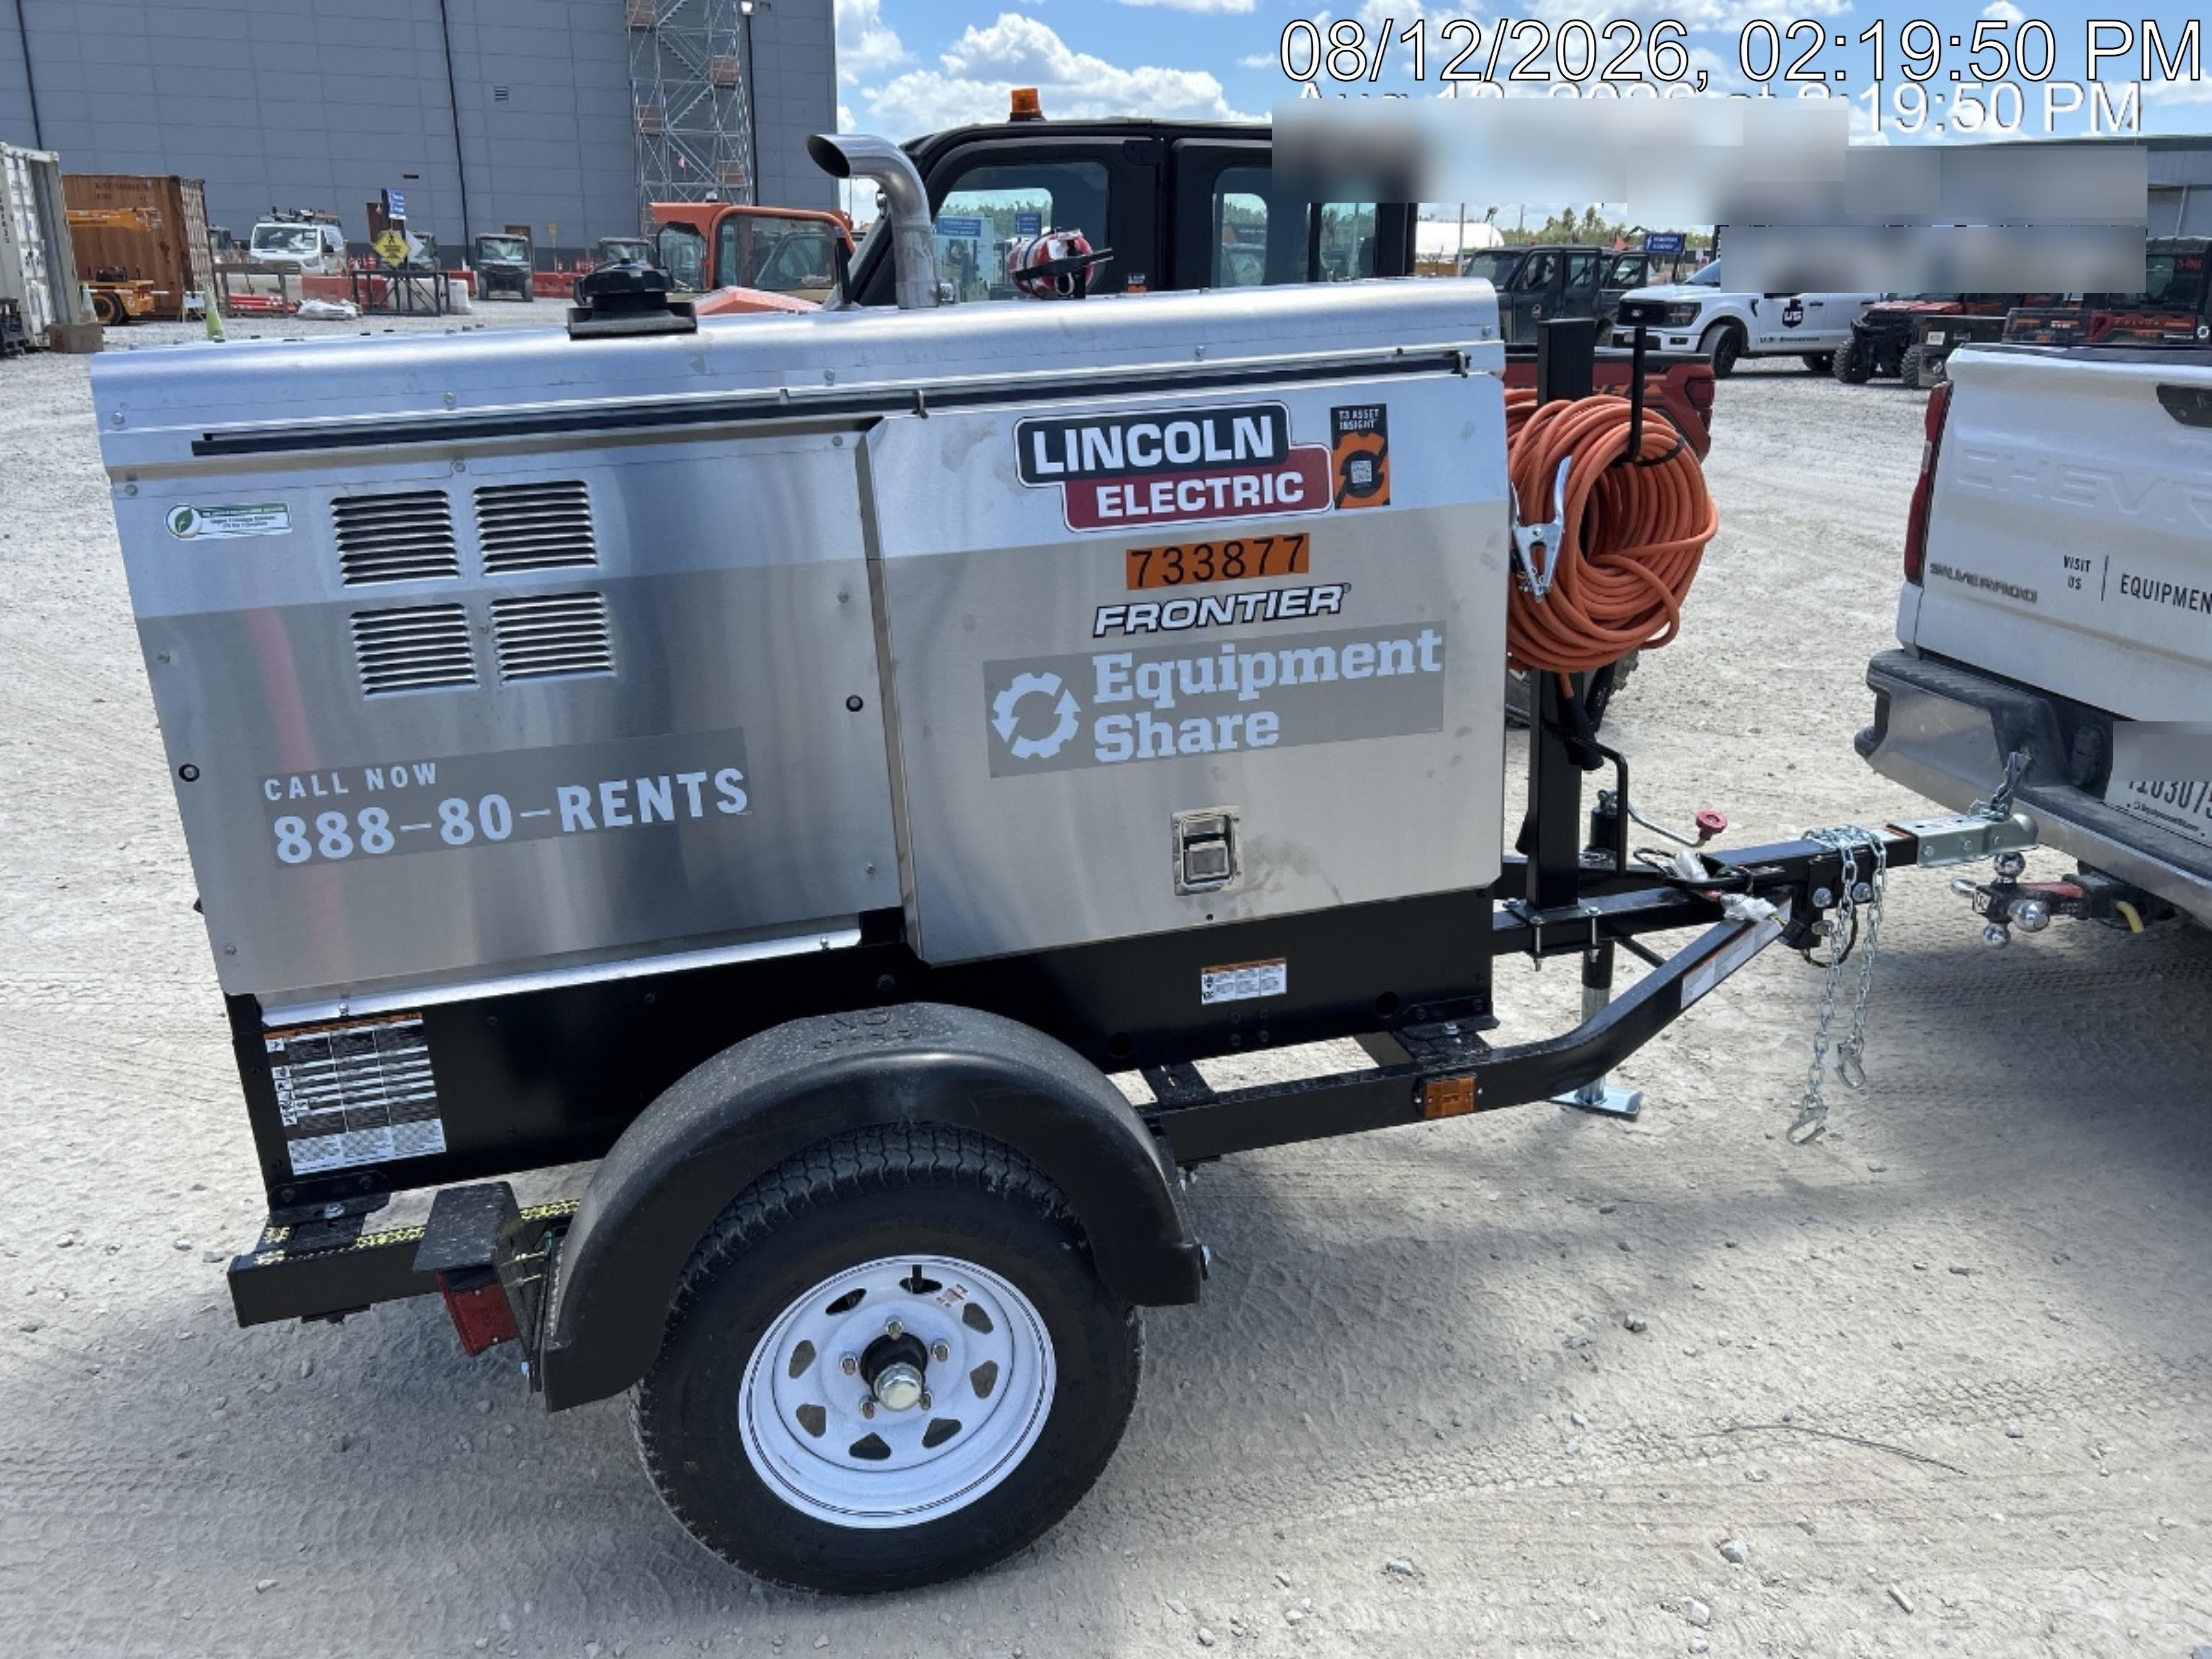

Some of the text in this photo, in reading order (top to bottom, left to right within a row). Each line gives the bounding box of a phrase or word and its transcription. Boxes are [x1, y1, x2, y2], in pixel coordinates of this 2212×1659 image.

[1352, 409, 1379, 420] ASSET
[1033, 415, 1274, 474] LINCOLN
[1096, 471, 1304, 519] ELECTRIC
[1131, 535, 1305, 588] 733877
[2063, 555, 2092, 573] VISIT
[2067, 576, 2082, 590] US
[1092, 628, 1443, 710] Equipment
[1094, 710, 1280, 763] Share
[264, 762, 437, 801] CALL NOW
[273, 767, 749, 865] 888-80-RENTS
